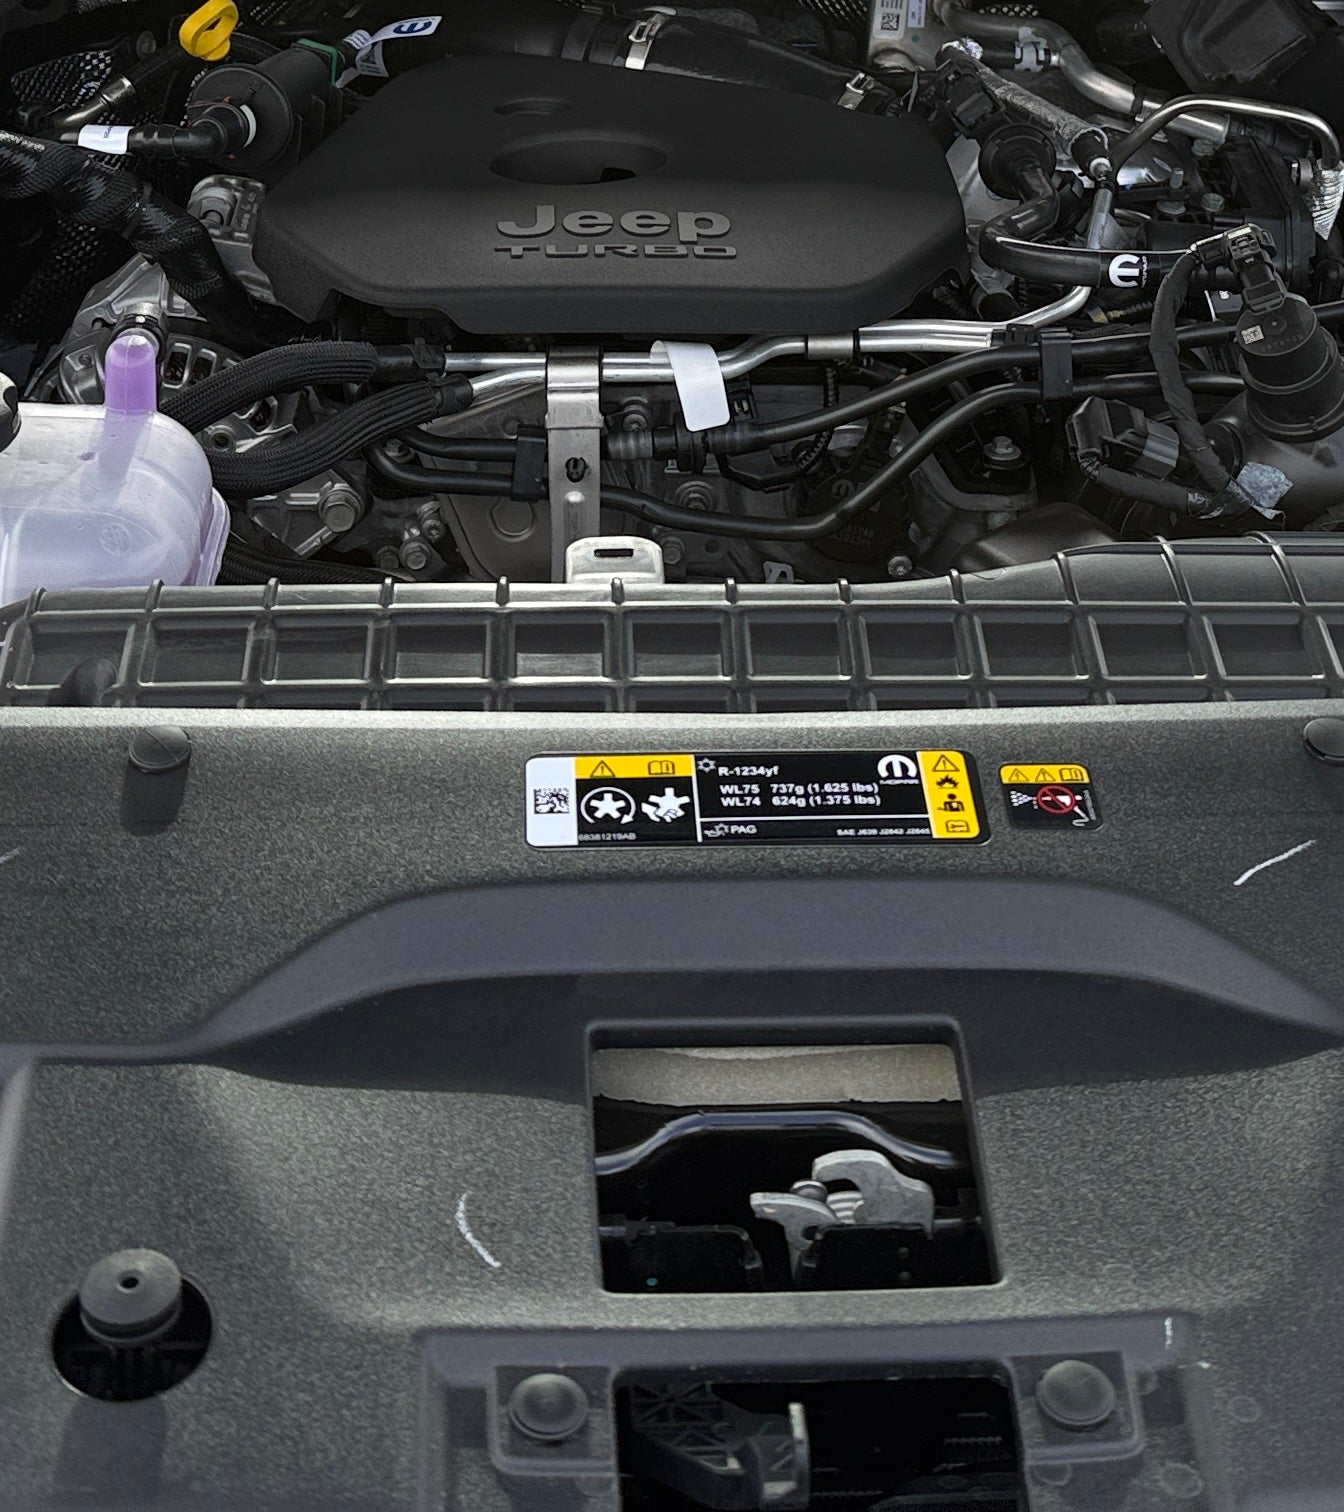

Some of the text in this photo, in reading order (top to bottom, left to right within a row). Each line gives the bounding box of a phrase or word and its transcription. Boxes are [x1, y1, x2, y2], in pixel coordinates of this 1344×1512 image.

[496, 204, 731, 245] Jeep
[494, 243, 737, 259] TURBO
[717, 765, 780, 778] R-1234yf
[719, 782, 879, 795] WL75 737g (1.625 lbs)
[720, 794, 882, 808] WL74 624g (1.375 lbs)
[730, 824, 758, 835] PAG
